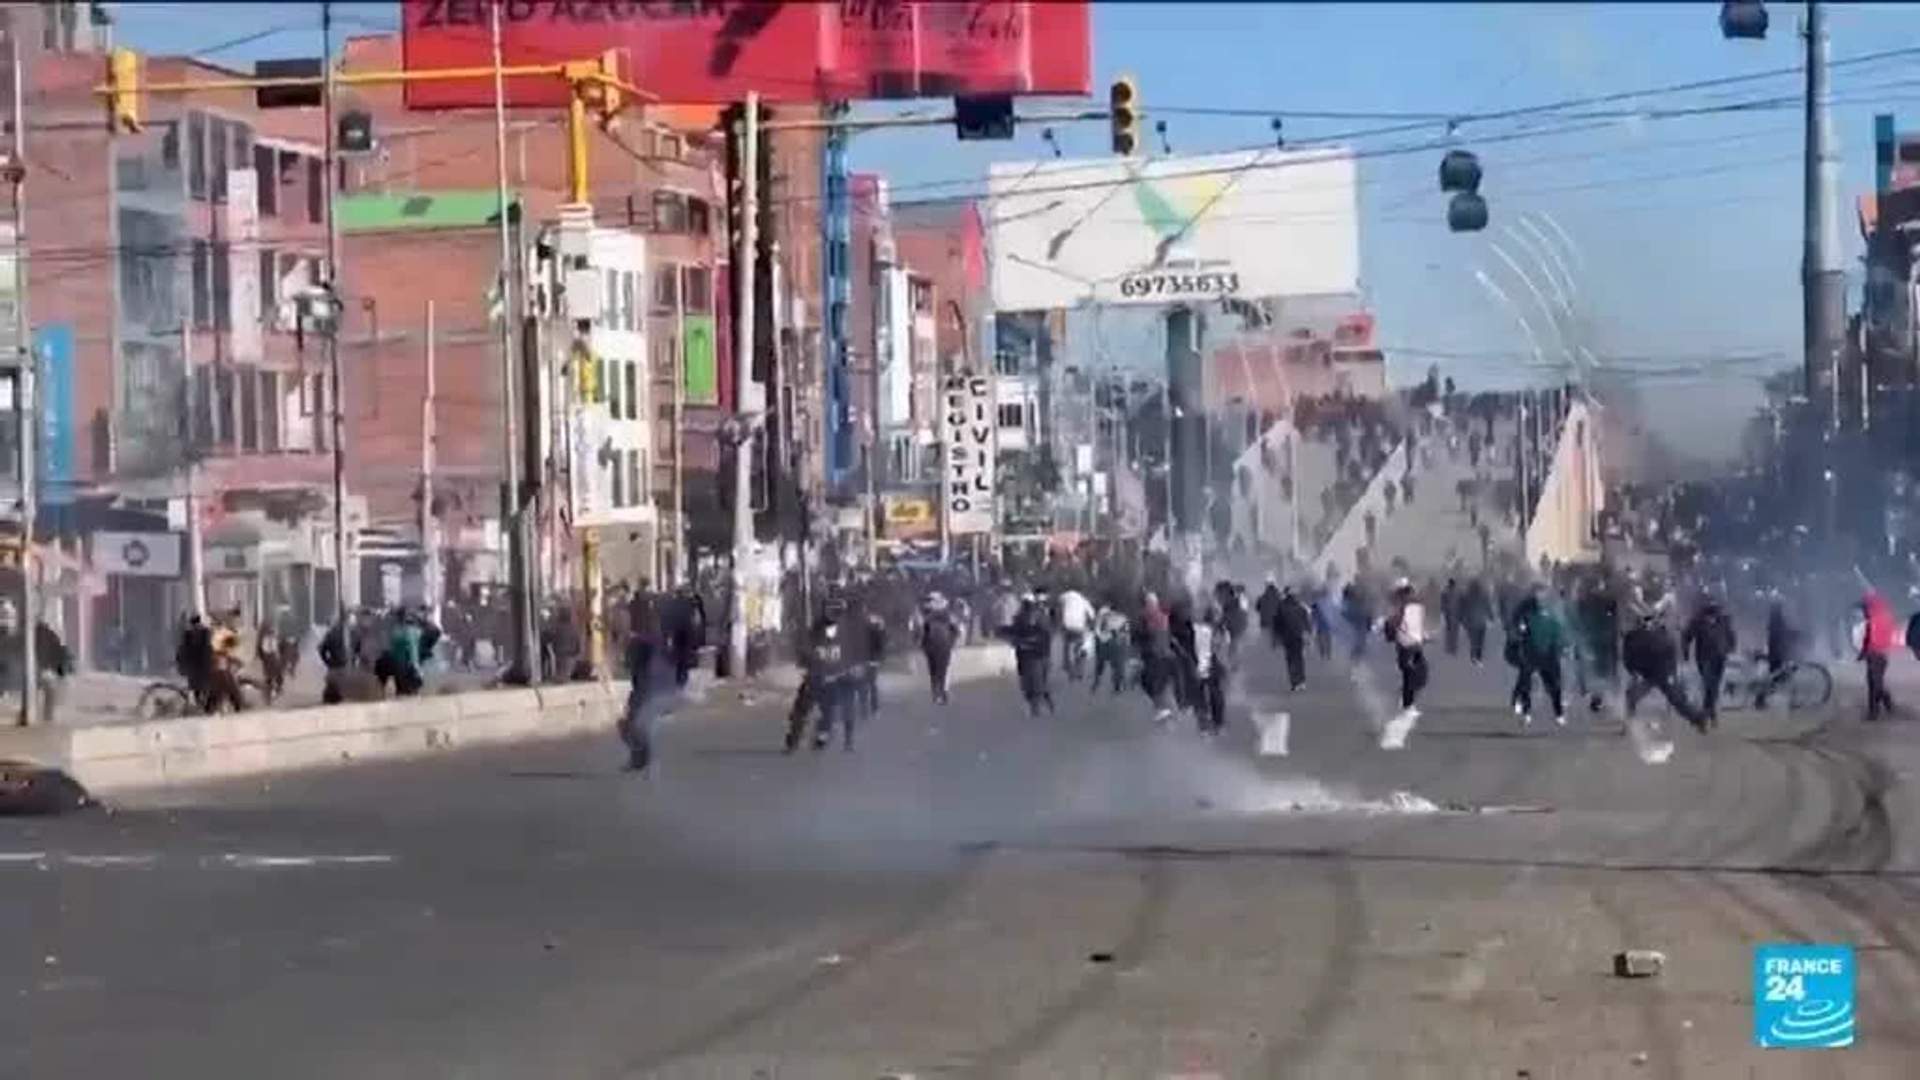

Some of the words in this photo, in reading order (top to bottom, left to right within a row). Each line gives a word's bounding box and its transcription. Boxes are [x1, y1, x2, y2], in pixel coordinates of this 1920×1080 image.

[1120, 272, 1239, 297] 69735633
[947, 377, 970, 512] REGISTRO
[969, 379, 990, 491] CIVIL
